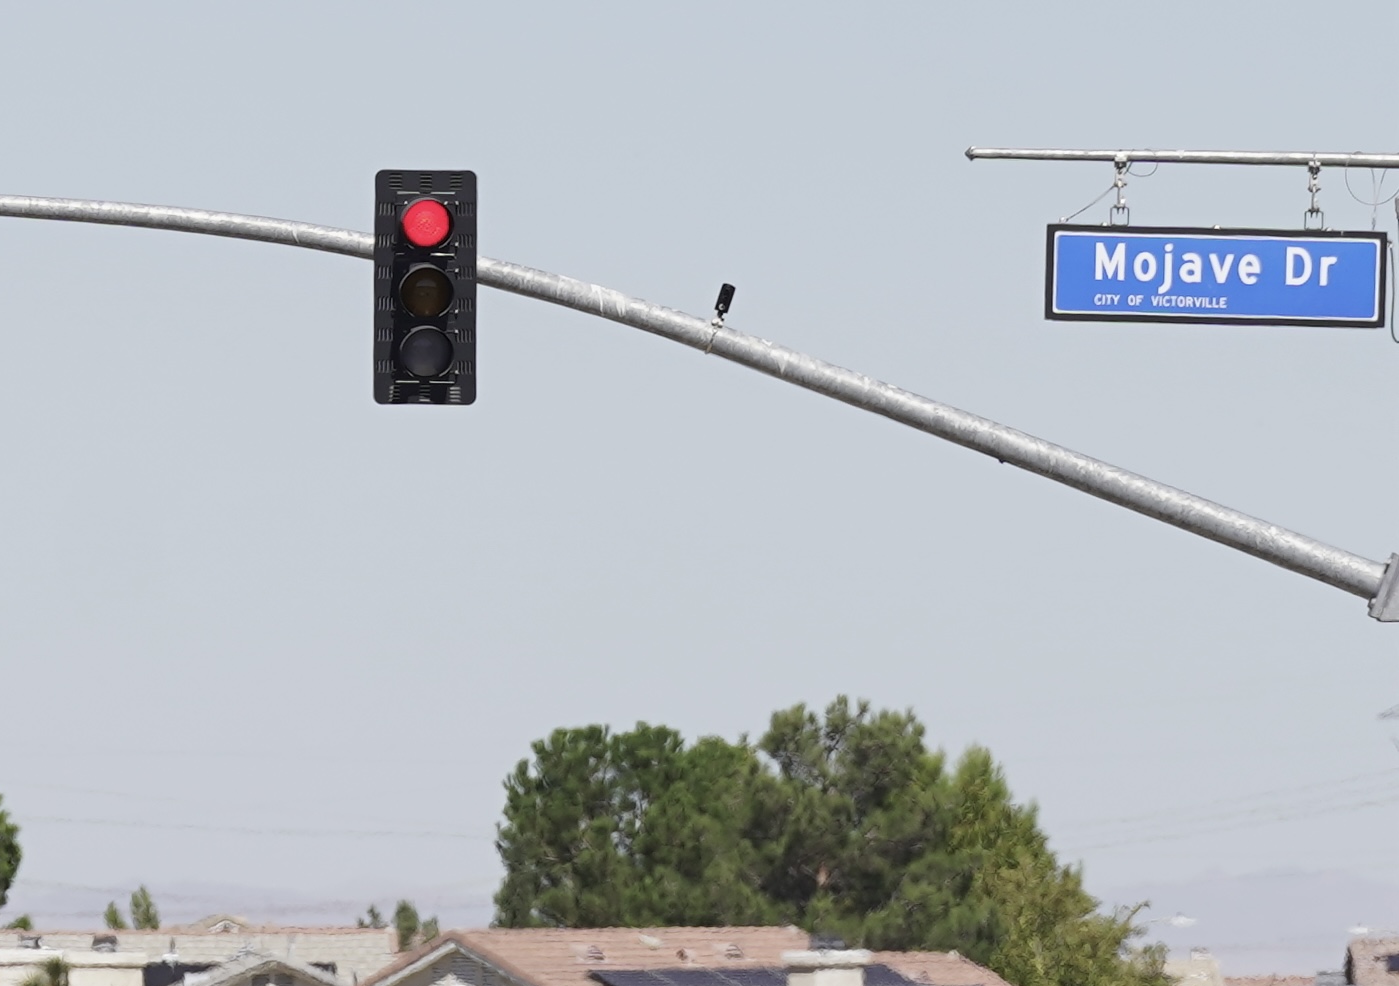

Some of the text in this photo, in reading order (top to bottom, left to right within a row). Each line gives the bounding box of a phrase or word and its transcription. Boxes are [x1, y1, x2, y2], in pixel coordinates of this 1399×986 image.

[1094, 242, 1338, 294] Mojave Dr
[1093, 293, 1228, 309] CITY OF VICTORVILLE
